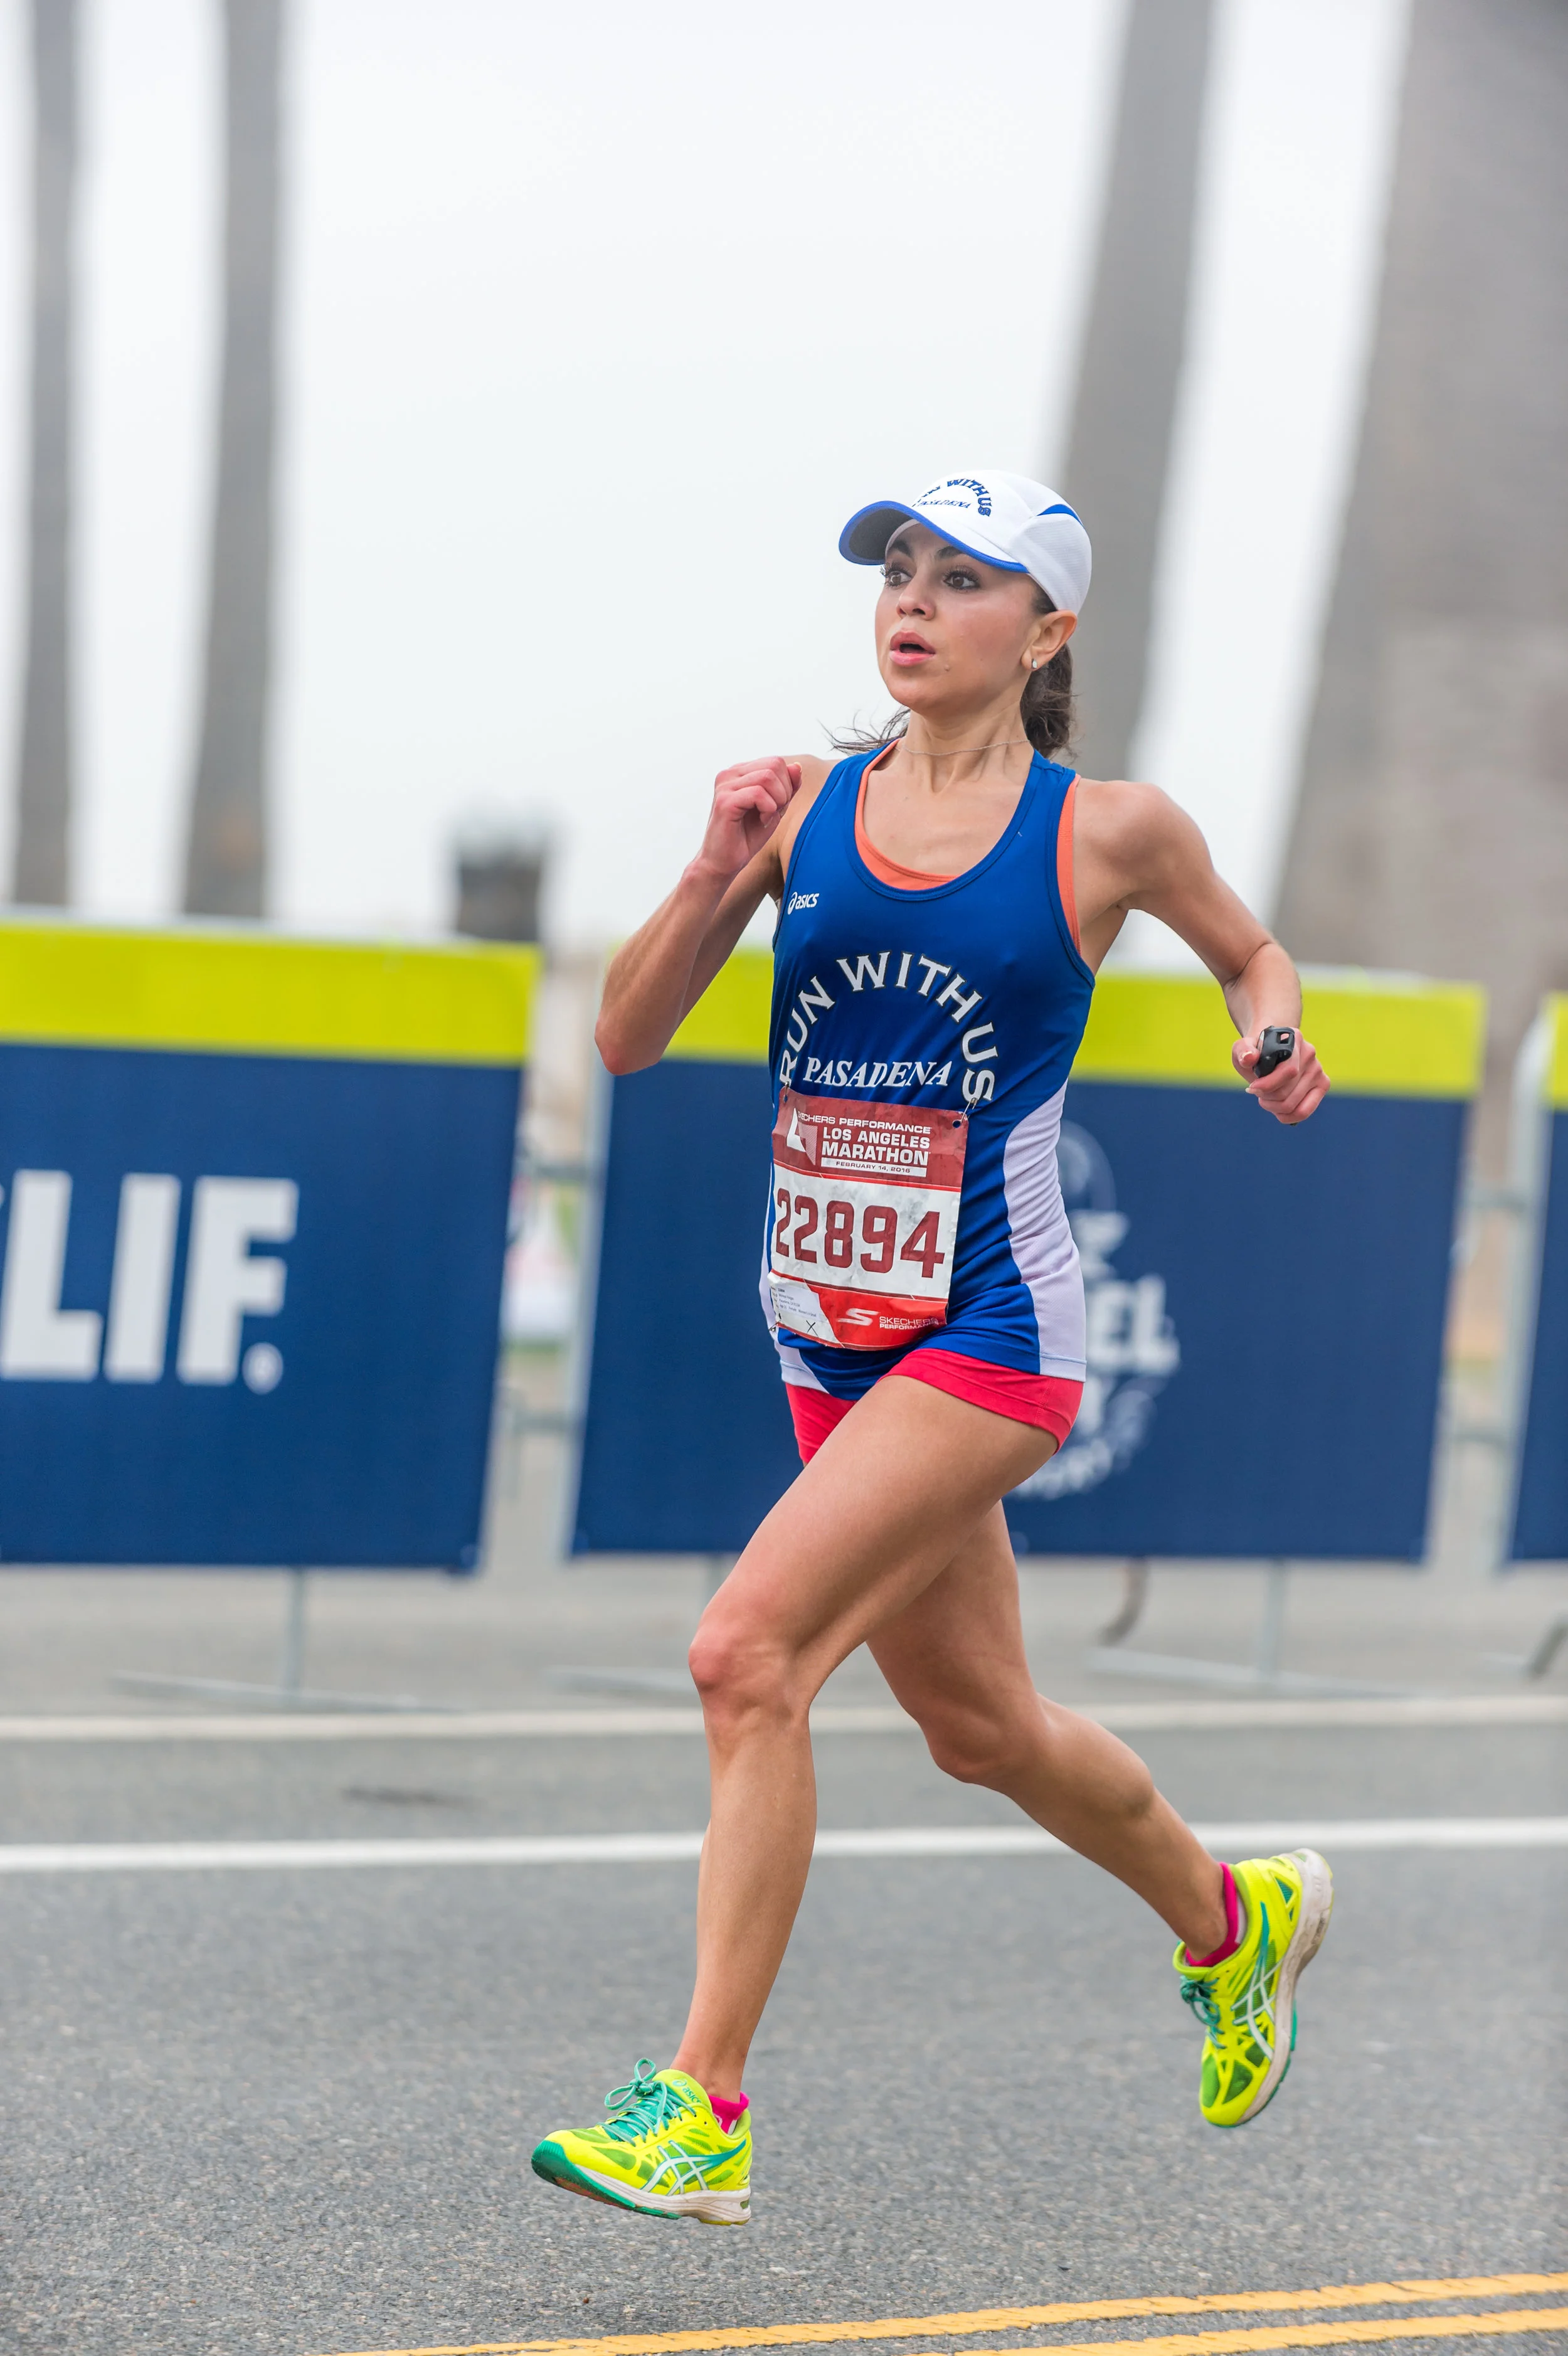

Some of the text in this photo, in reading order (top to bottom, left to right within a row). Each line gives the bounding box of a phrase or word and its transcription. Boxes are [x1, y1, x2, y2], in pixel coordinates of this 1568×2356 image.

[947, 478, 992, 517] WITH US
[780, 951, 999, 1101] RUN WITH US
[803, 1056, 953, 1088] PASADENA
[798, 1111, 932, 1135] SKECHERS PERFORMANCE
[823, 1127, 930, 1149] LOS ANGELES
[822, 1140, 929, 1165] MARATHON
[836, 1161, 876, 1170] FEBRUARY
[776, 1187, 945, 1278] 22894
[0, 1168, 300, 1395] LIF.
